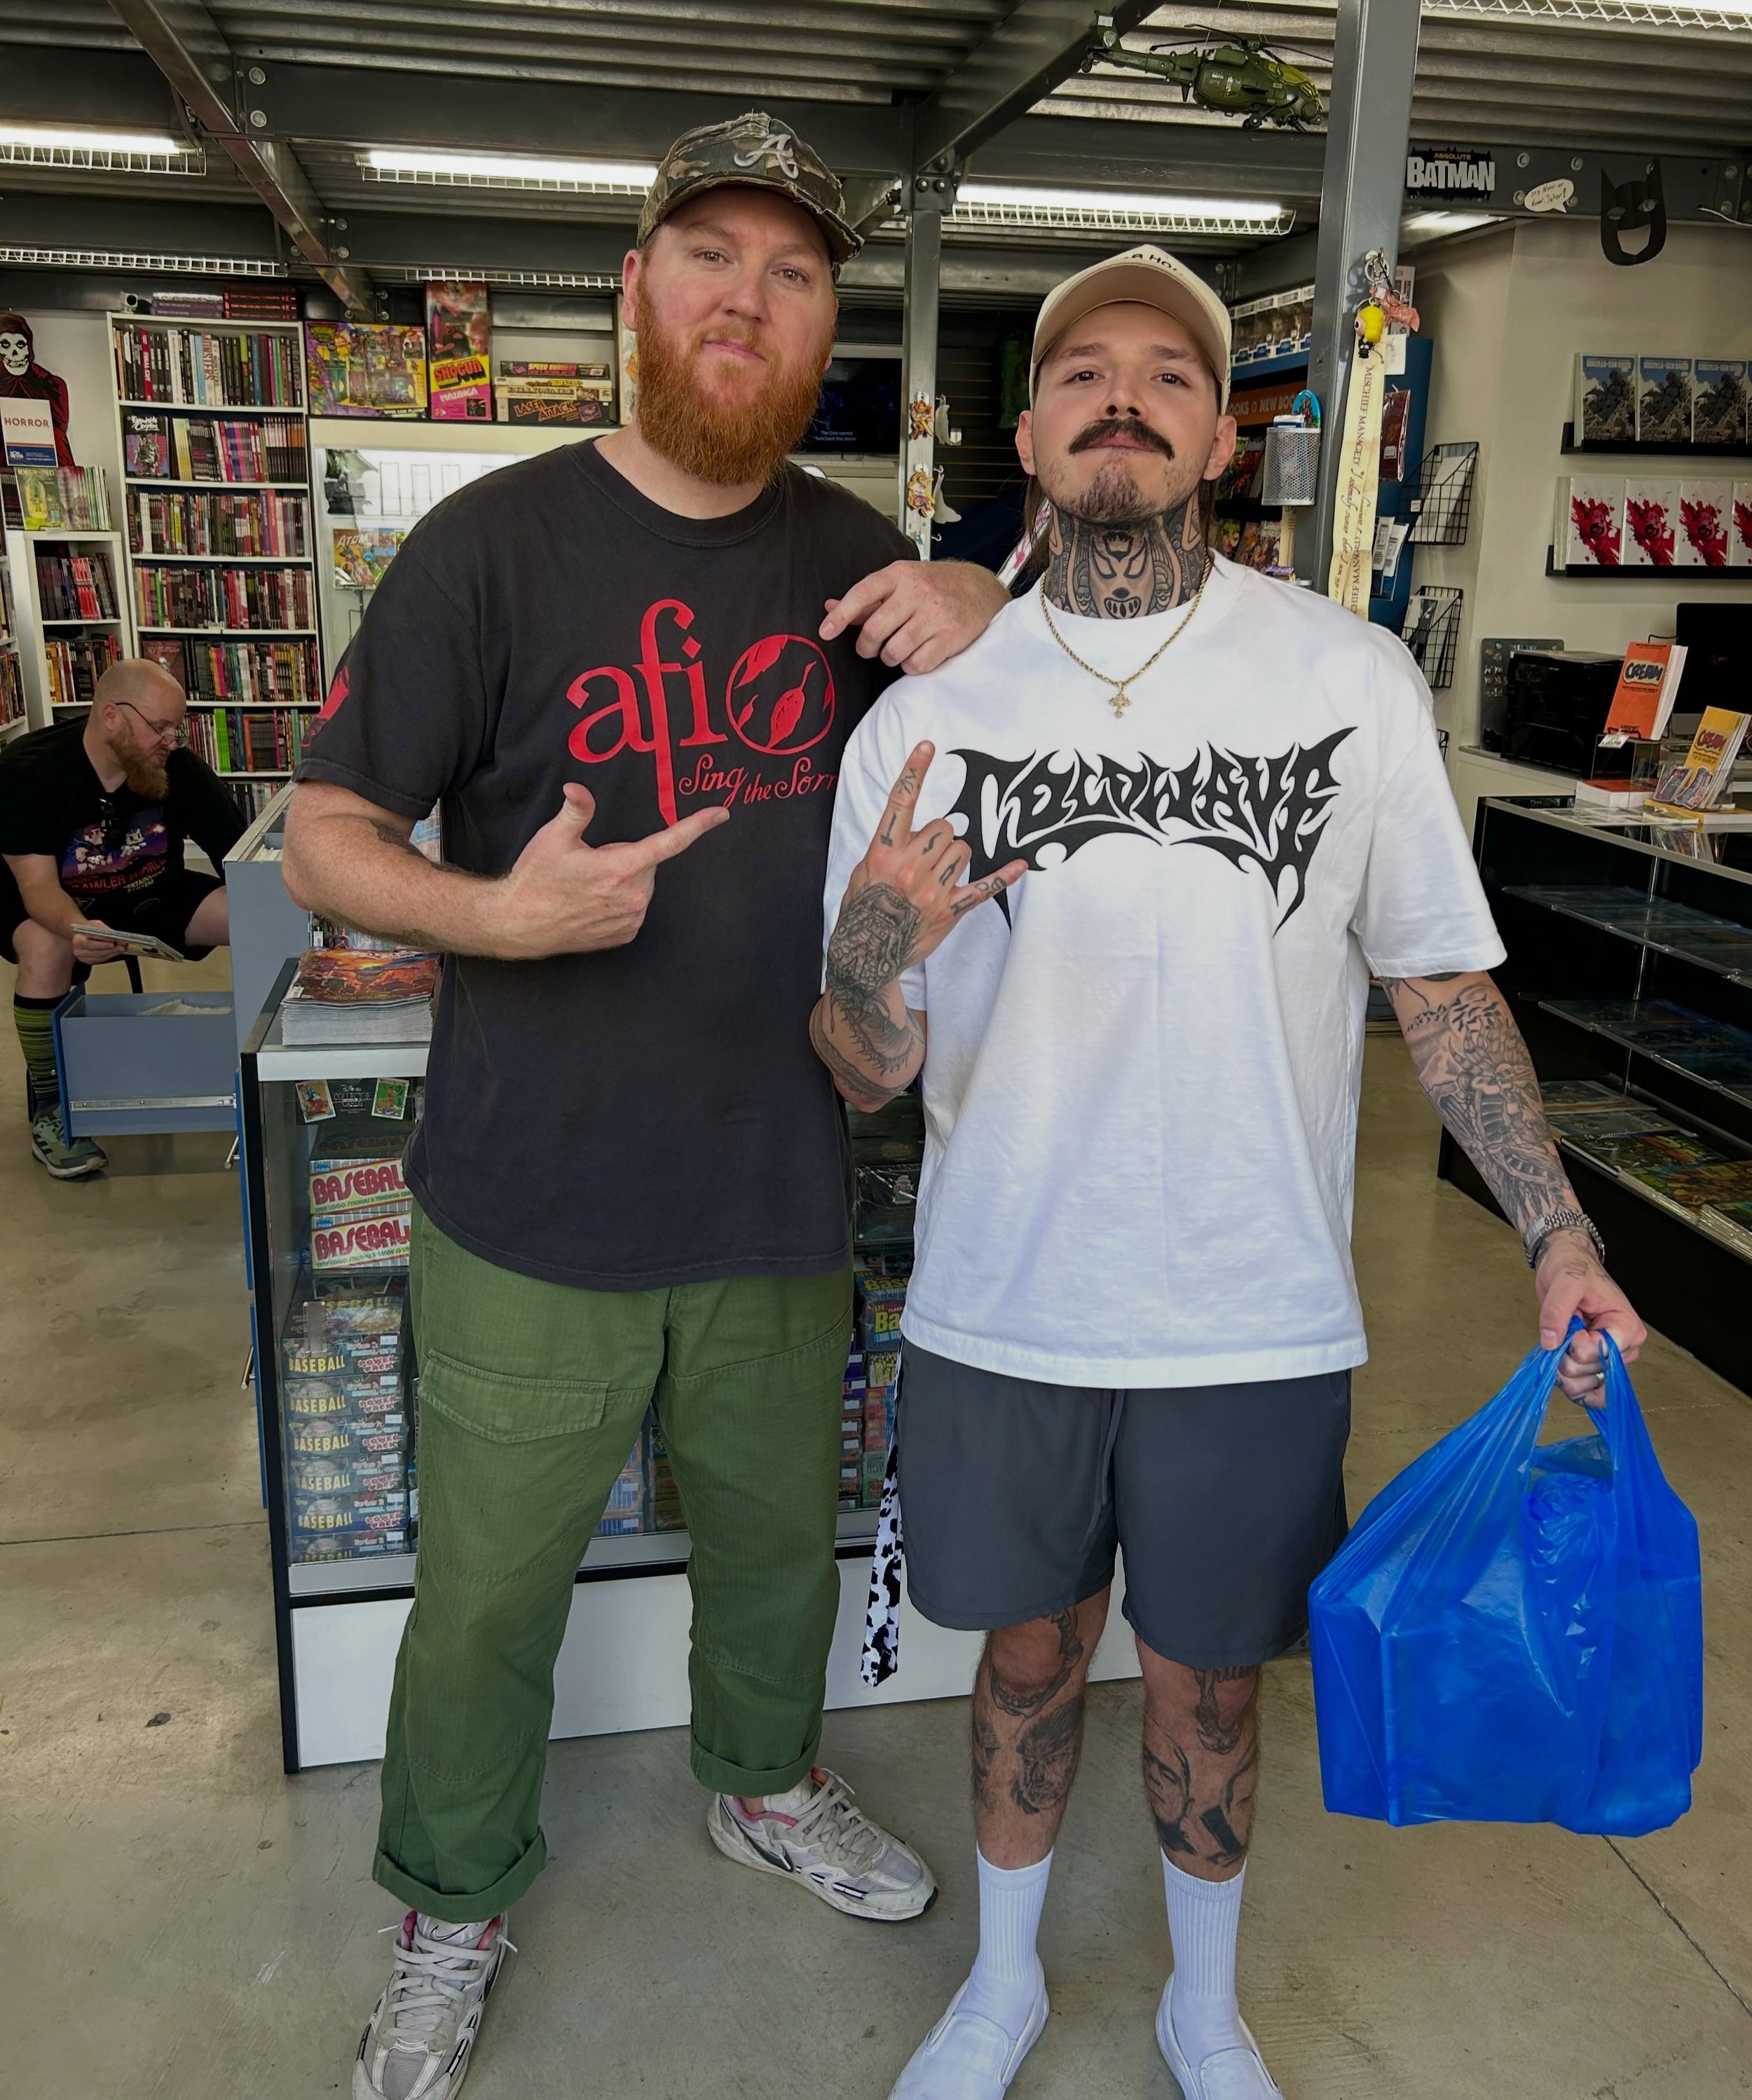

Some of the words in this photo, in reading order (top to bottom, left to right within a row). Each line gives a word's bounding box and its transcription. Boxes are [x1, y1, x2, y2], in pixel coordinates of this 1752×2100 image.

[1407, 156, 1496, 191] BATMAN
[433, 358, 483, 381] SHOGUN
[515, 400, 546, 416] LASER
[540, 402, 575, 419] ATTACK
[1260, 397, 1278, 412] NEW
[4, 417, 50, 428] HORROR
[336, 533, 369, 550] ATOM
[1624, 661, 1664, 682] CREAM
[566, 598, 728, 826] afi
[678, 753, 746, 809] Sing
[744, 773, 772, 804] the
[288, 1354, 345, 1373] BASEBALL
[290, 1395, 346, 1413] BASEBALL
[294, 1434, 350, 1452] BASEBALL
[299, 1511, 353, 1529] BASEBALL
